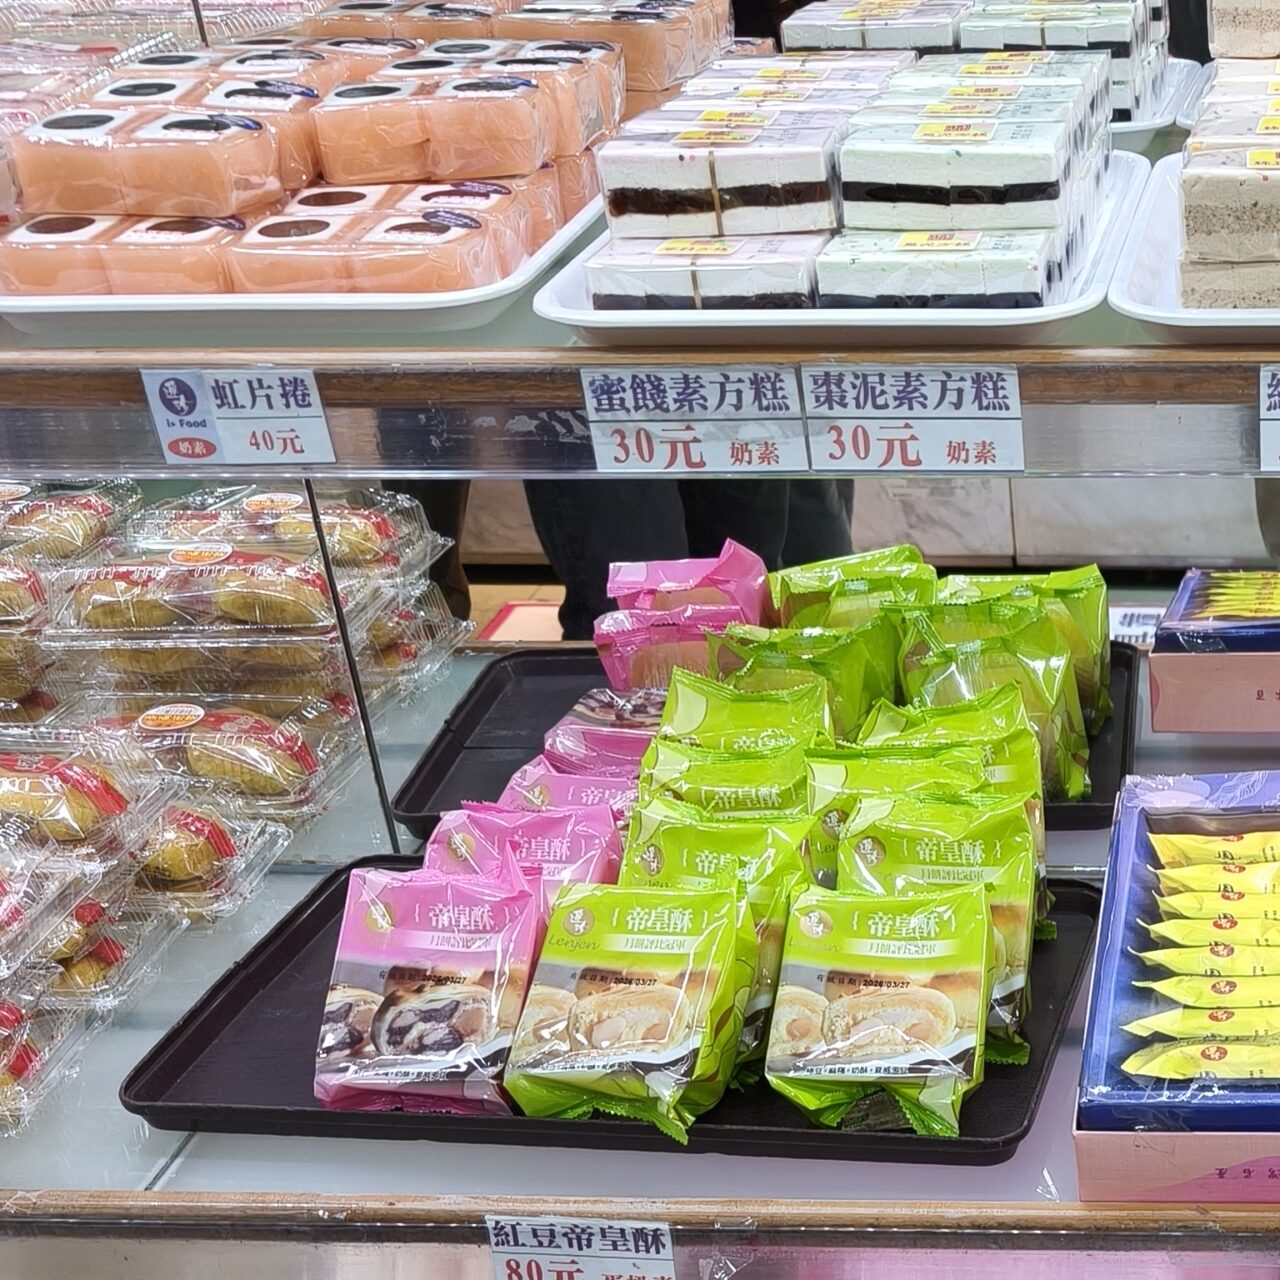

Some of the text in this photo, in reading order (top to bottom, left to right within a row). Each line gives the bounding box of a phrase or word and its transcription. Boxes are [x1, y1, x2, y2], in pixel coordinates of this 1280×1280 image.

[211, 376, 313, 411] 虹片捲
[590, 372, 792, 414] 蜜餞素方糕
[808, 371, 1011, 413] 棗泥素方糕
[179, 418, 207, 428] Food
[249, 428, 305, 455] 40元
[610, 424, 781, 470] 30元 奶素
[826, 422, 998, 468] 30元 奶素
[916, 838, 987, 865] 帝皇酥
[429, 903, 494, 931] 帝皇酥
[626, 907, 694, 933] 帝皇酥
[868, 912, 941, 938] 帝皇酥
[491, 1220, 667, 1255] 紅豆帝皇酥
